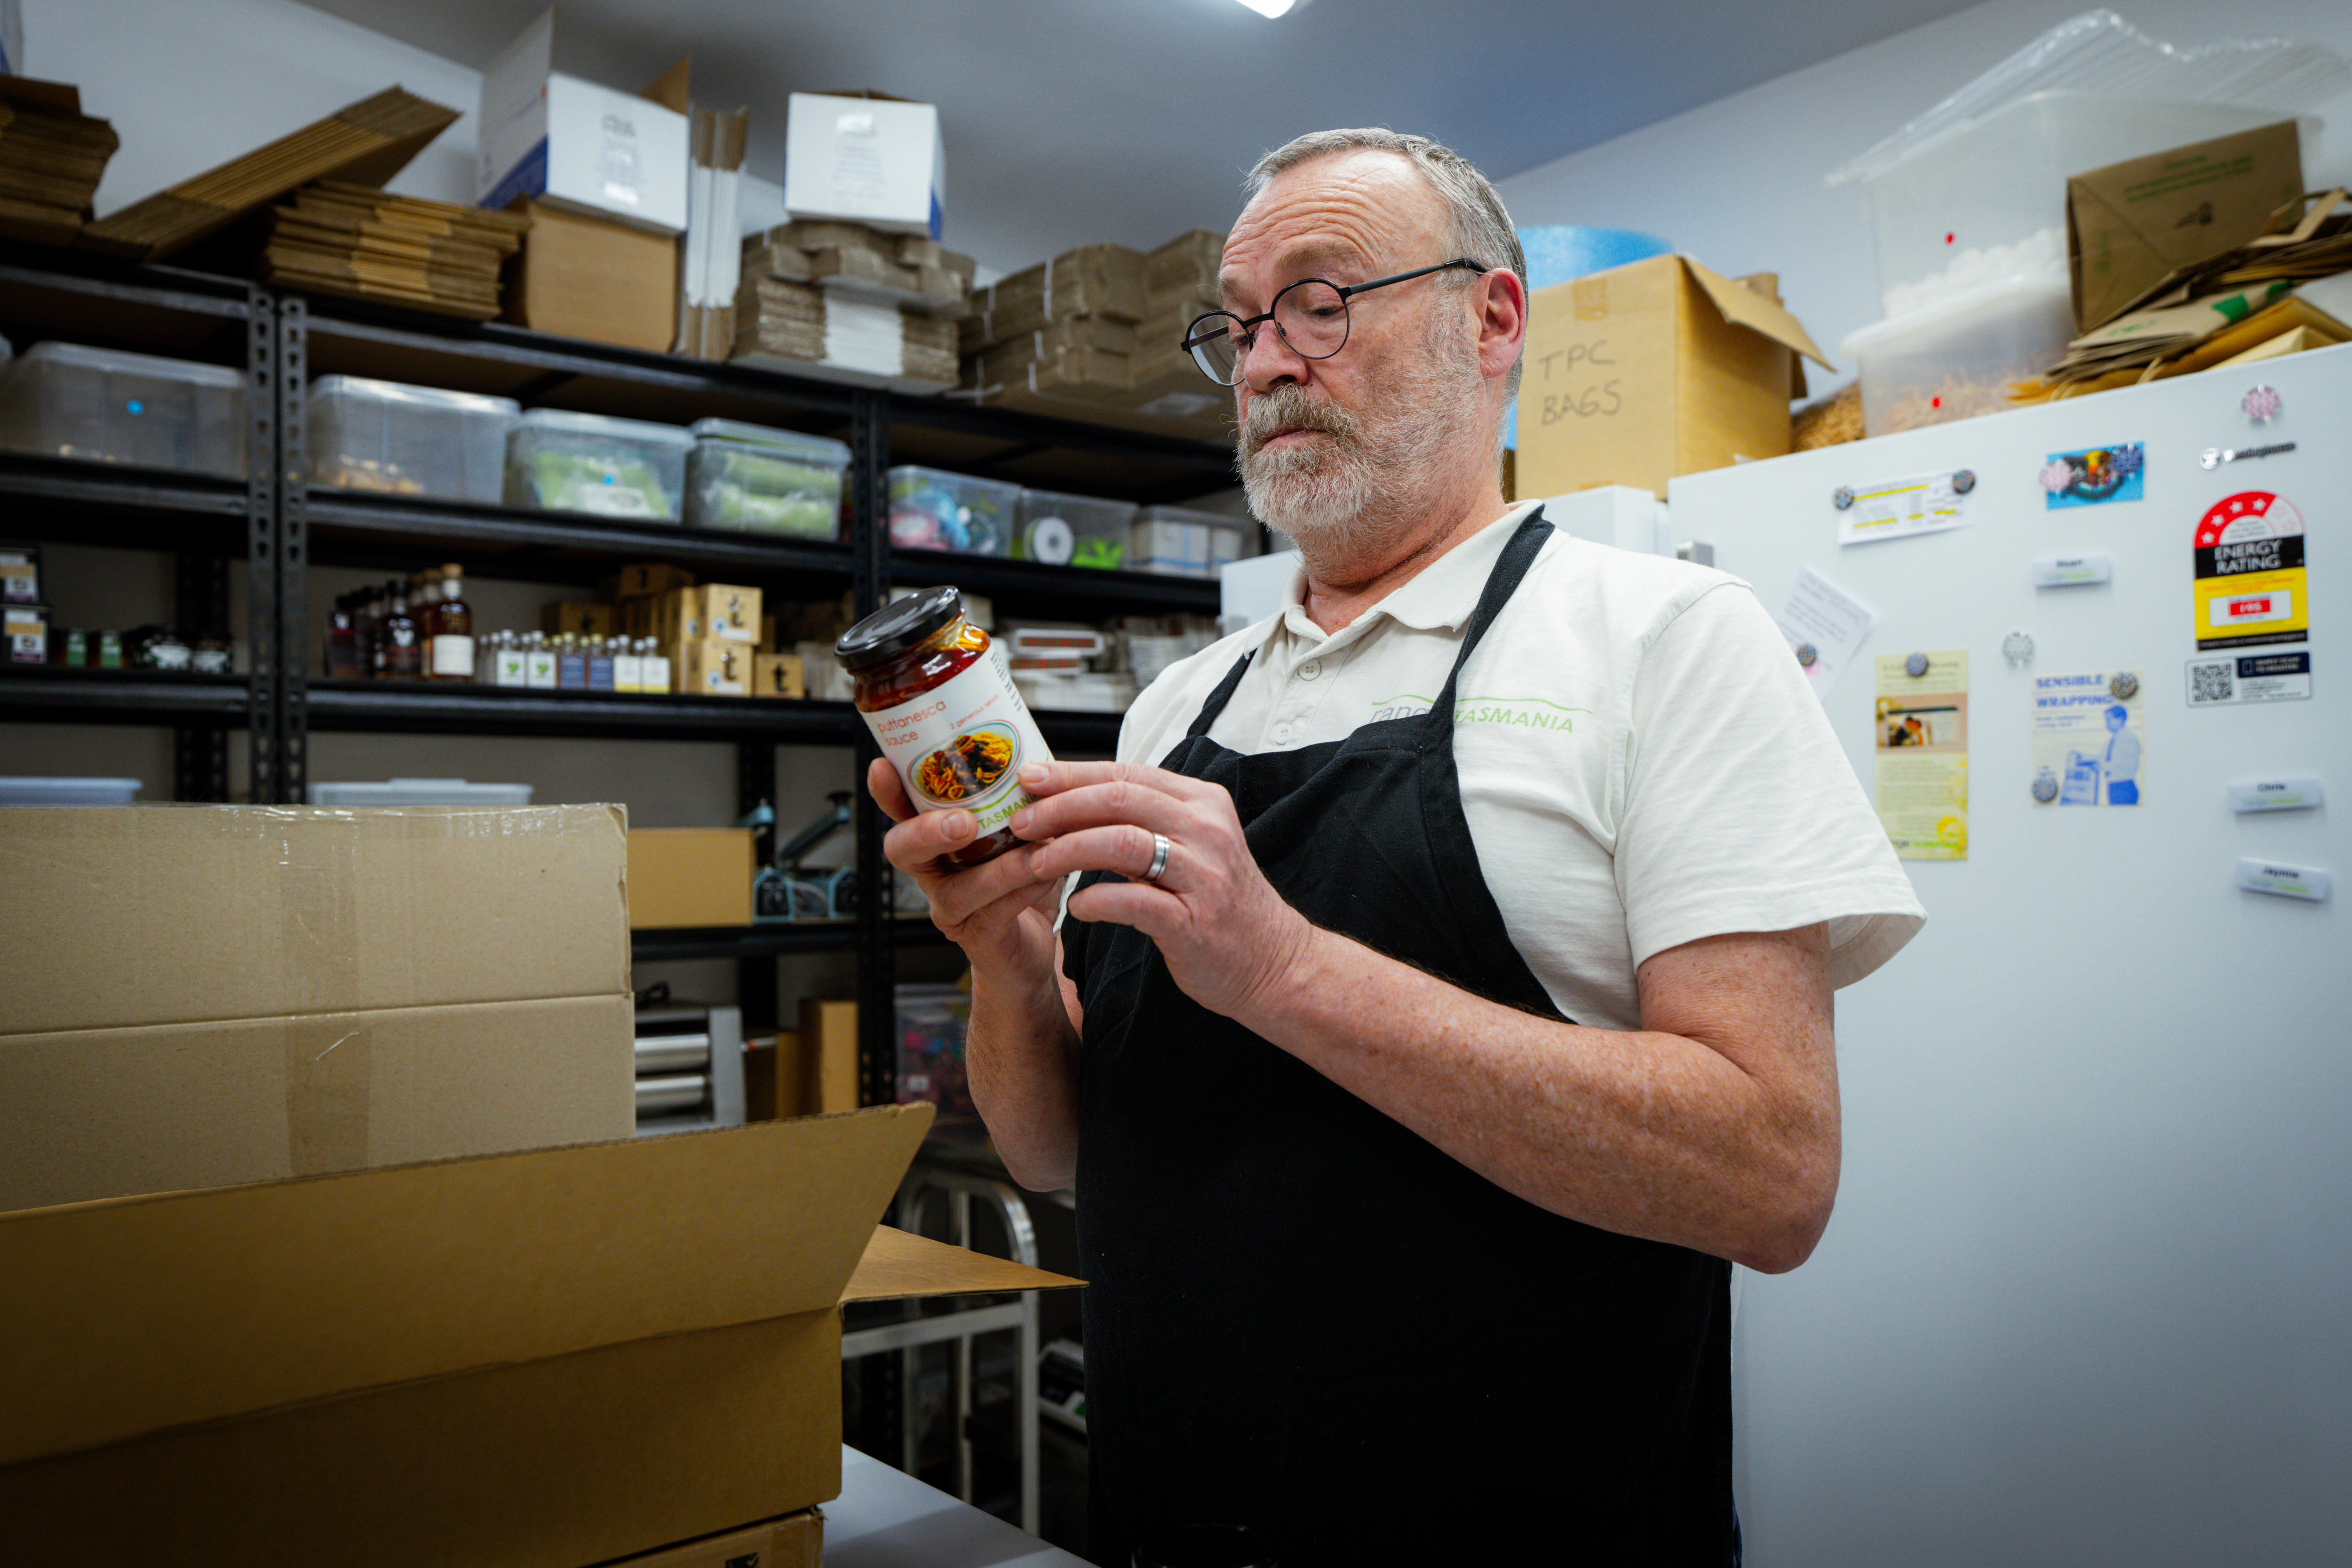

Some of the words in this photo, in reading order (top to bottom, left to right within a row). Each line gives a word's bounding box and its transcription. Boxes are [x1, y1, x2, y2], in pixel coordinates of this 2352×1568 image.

[1538, 339, 1616, 380] TPC
[1541, 379, 1623, 426] BAGS
[2215, 539, 2282, 561] ENERGY
[2217, 553, 2281, 575] RATING
[2036, 674, 2103, 689] SENSIBLE
[2036, 693, 2114, 708] WRAPPING
[877, 701, 946, 733] puttanesca
[1454, 707, 1573, 733] TASMANIA
[885, 732, 918, 746] sauce
